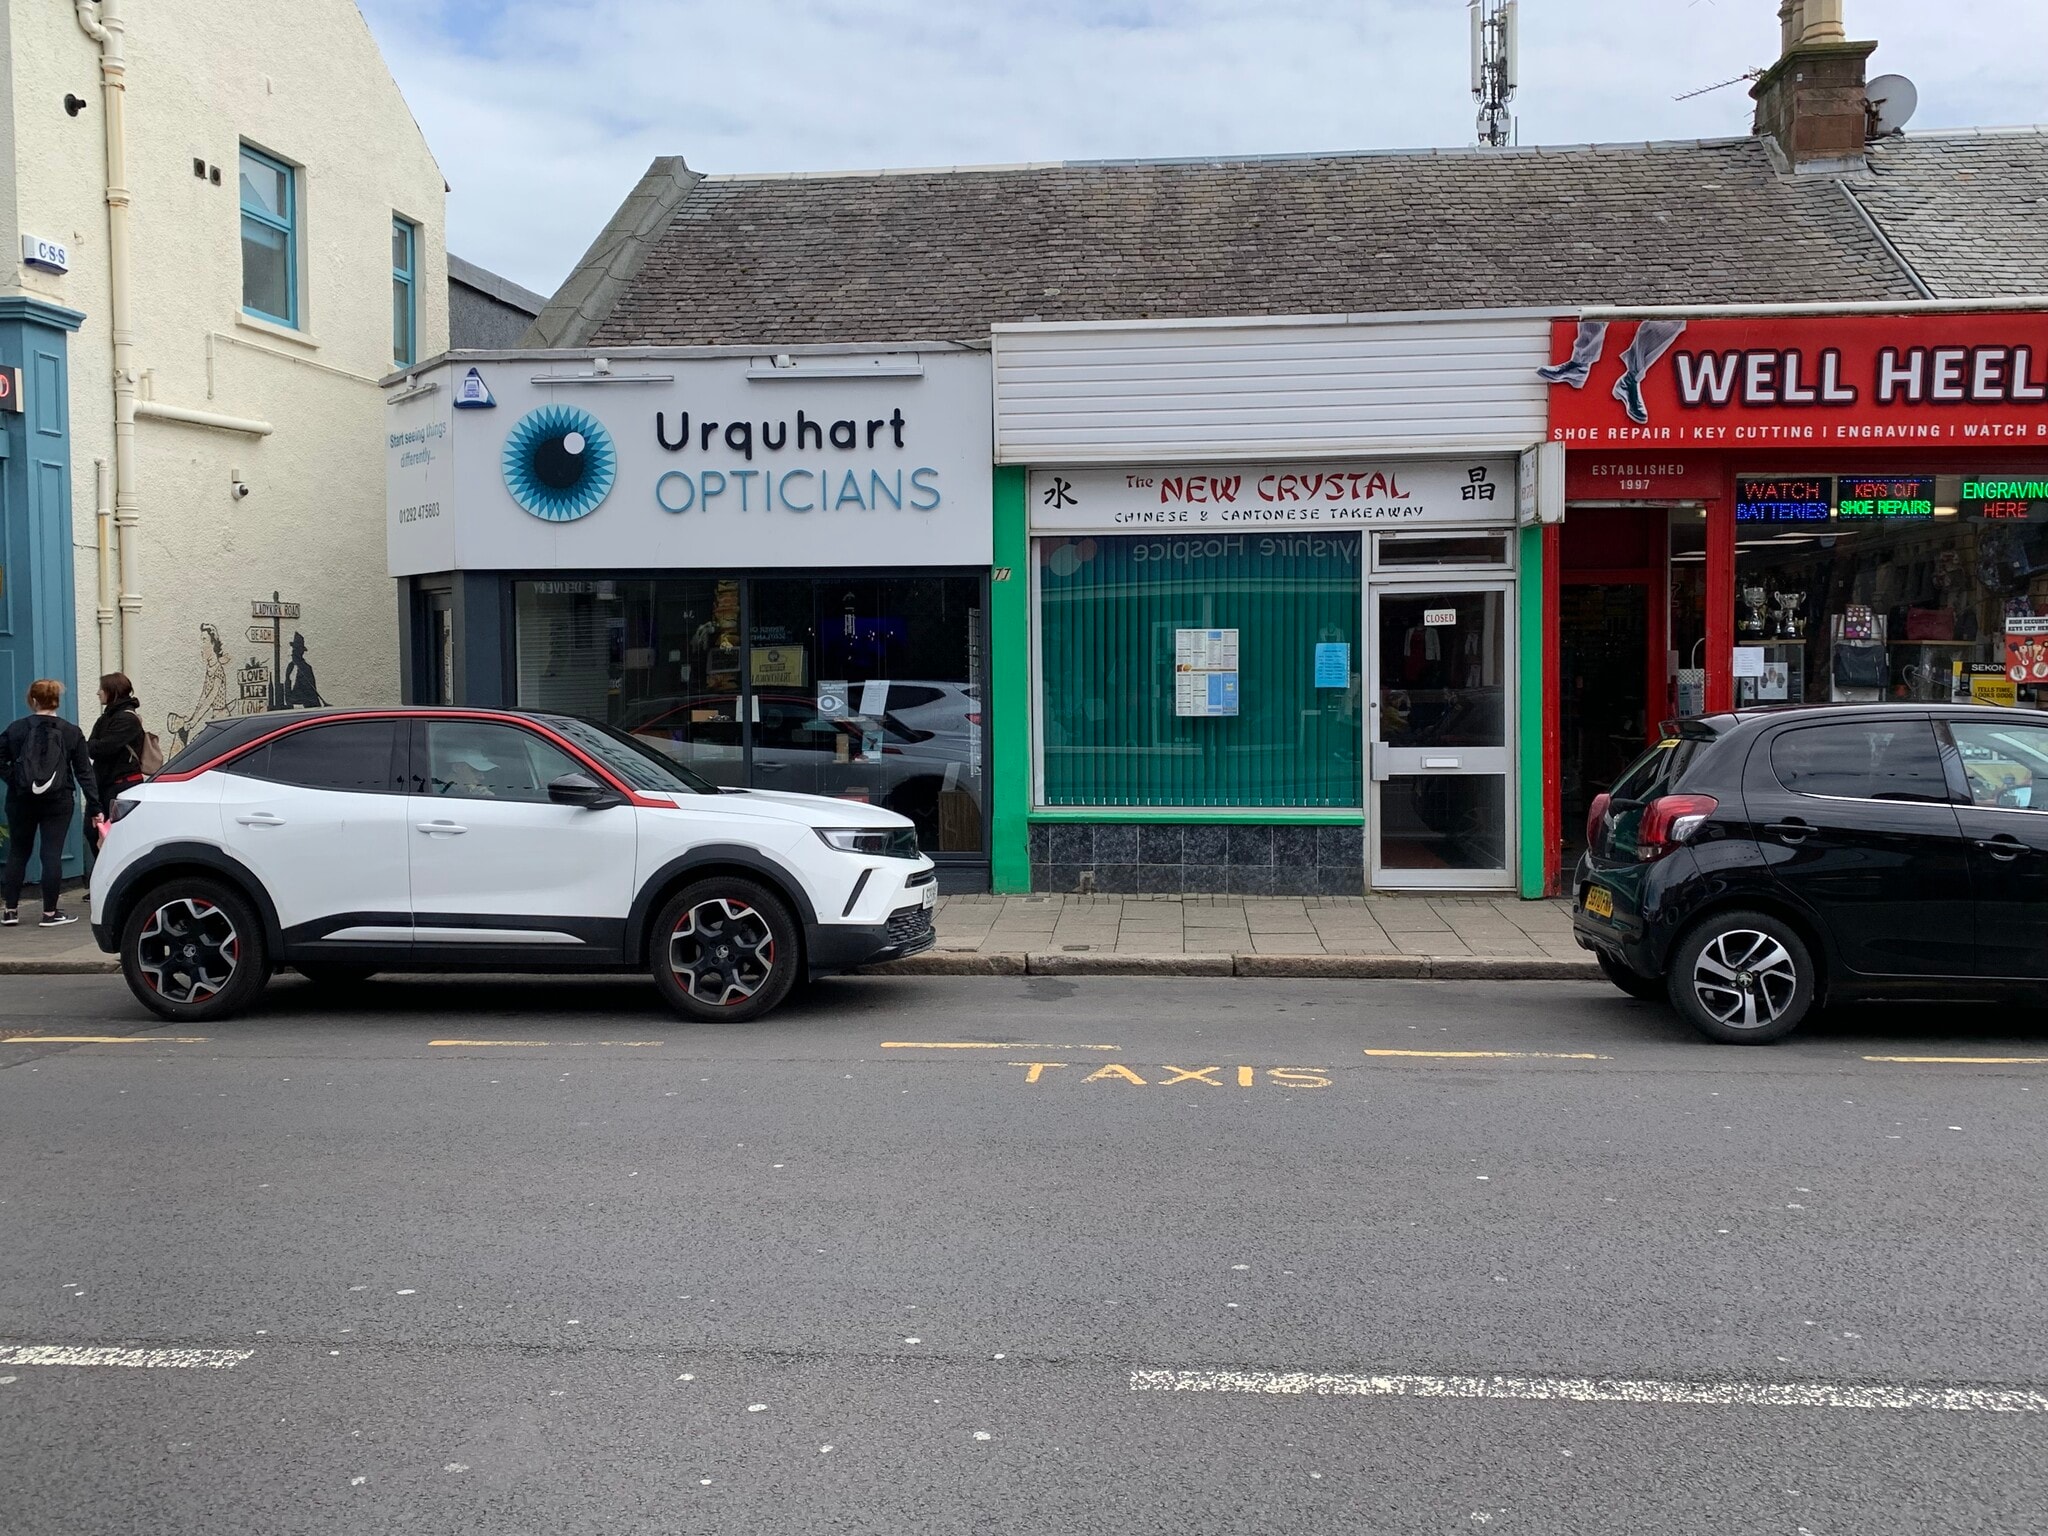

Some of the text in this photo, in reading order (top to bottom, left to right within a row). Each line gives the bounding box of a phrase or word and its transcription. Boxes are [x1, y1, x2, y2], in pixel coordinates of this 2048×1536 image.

[1676, 353, 1854, 402] WELL
[389, 421, 447, 448] Start seeing things
[656, 407, 905, 461] Urquhart
[1554, 427, 1599, 440] SHOE
[1608, 427, 1671, 439] REPAIR
[1693, 426, 1727, 439] KEY
[1735, 426, 1814, 439] CUTTING
[1836, 425, 1941, 438] ENGRAVING
[1963, 424, 2028, 437] WATCH
[1592, 464, 1685, 476] ESTABLISHED
[655, 466, 941, 514] OPTICIANS
[1126, 470, 1410, 504] The NEW CRYSTAL
[1460, 466, 1496, 501] 晶
[1619, 479, 1650, 490] 1997
[1744, 482, 1820, 500] WATCH
[1854, 482, 1920, 498] KEYS CUT
[1043, 476, 1078, 509] 水
[399, 506, 417, 523] 01292
[1114, 506, 1424, 523] CHINESE & CANTONESE TAKEAWAY
[1736, 502, 1828, 520] BATTERIES
[1839, 500, 1932, 515] SHOE REPAIRS
[1983, 502, 2029, 518] HERE
[995, 567, 1011, 581] 77
[284, 603, 300, 617] ROAD
[1425, 613, 1455, 623] CLOSED
[250, 628, 272, 641] BEACH
[241, 669, 264, 683] LOVE
[243, 685, 264, 698] LIFE
[1008, 1062, 1333, 1088] TAXIS
